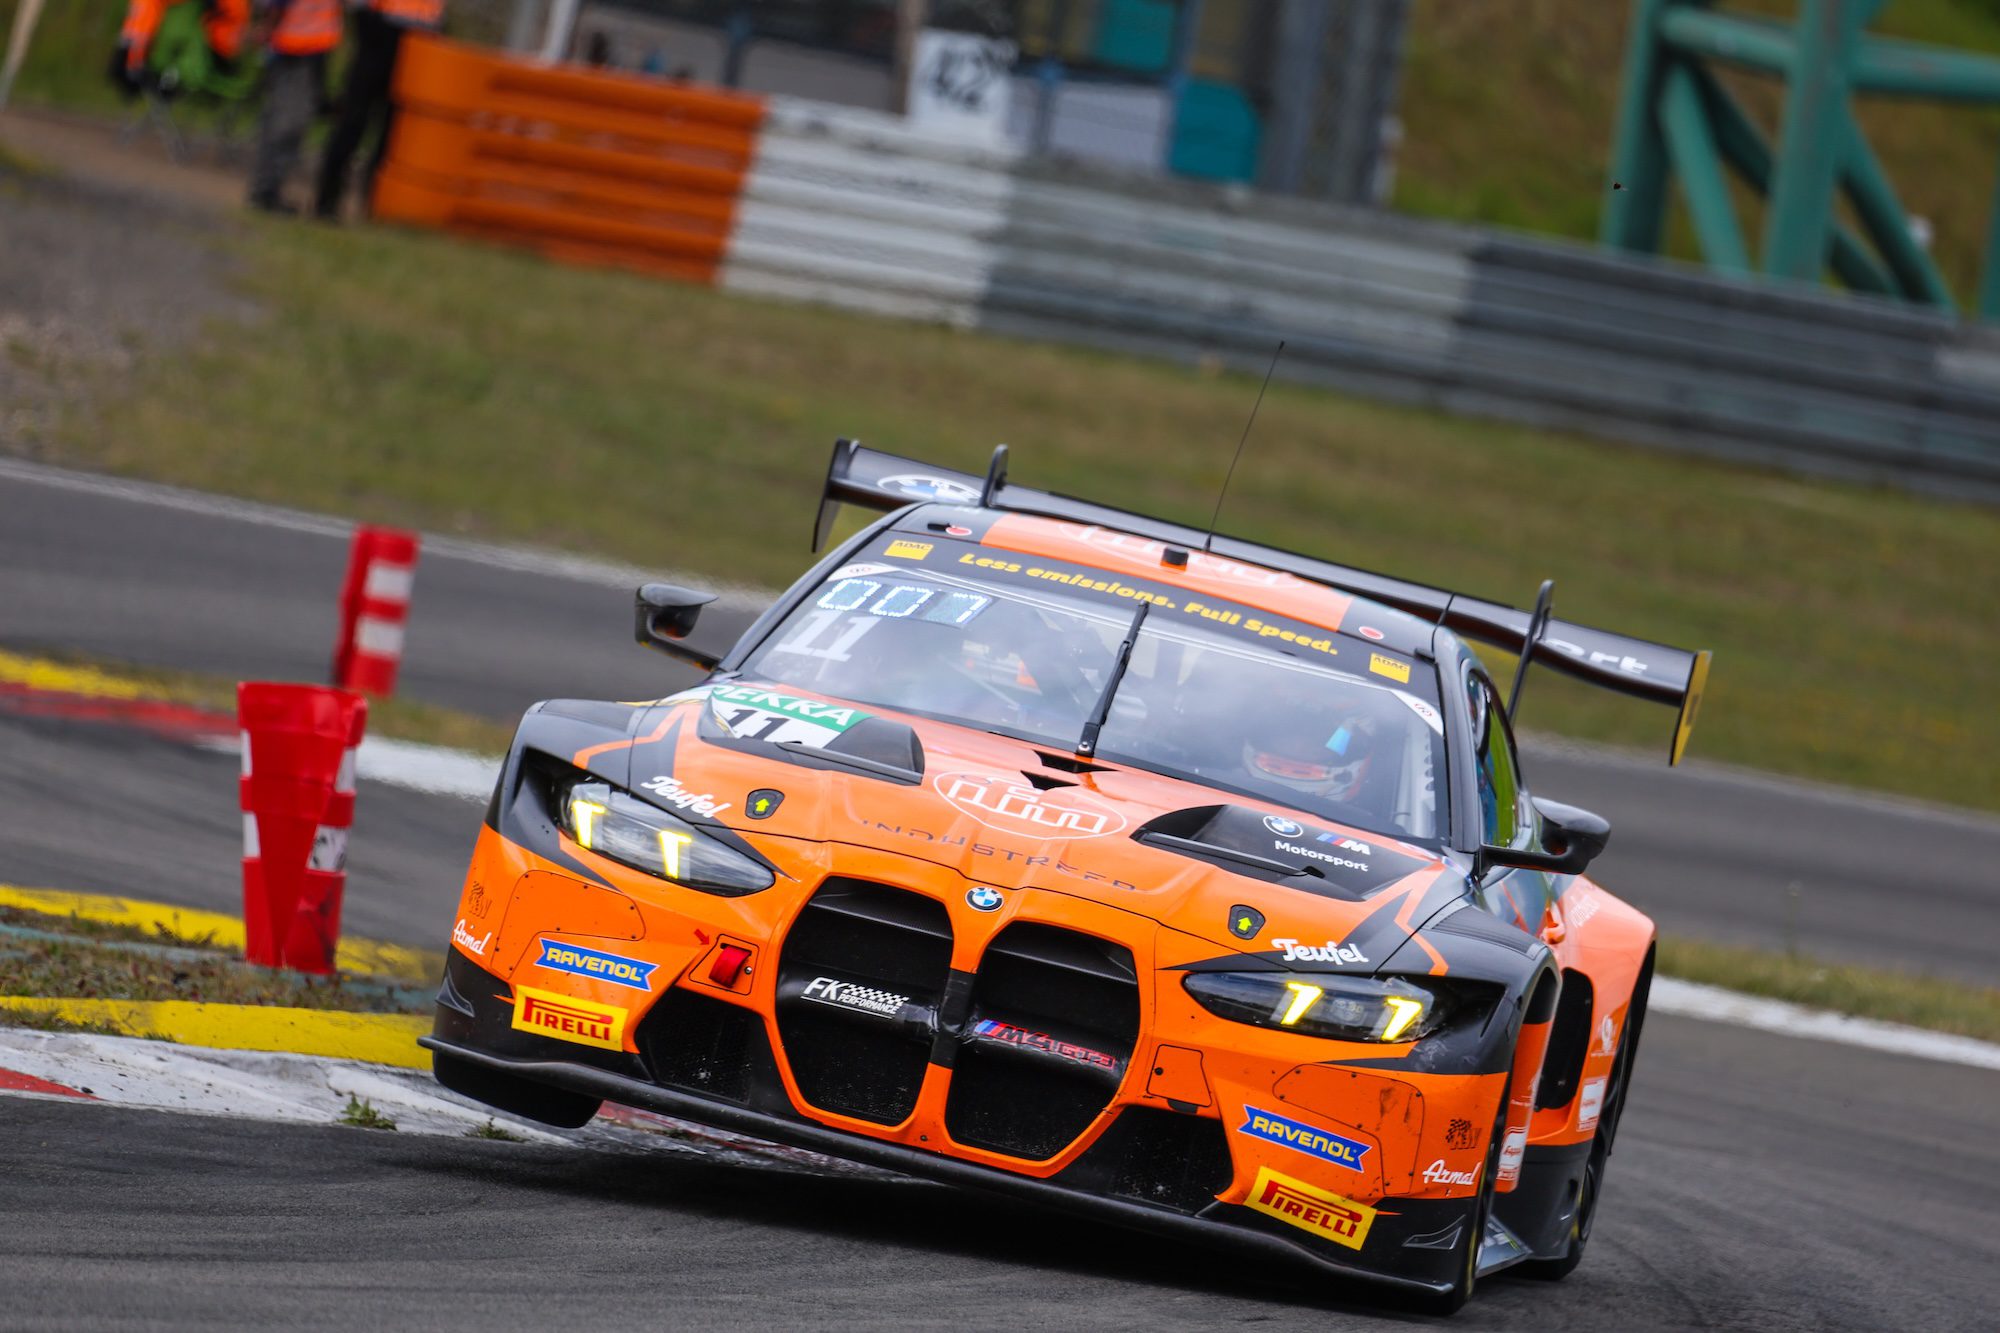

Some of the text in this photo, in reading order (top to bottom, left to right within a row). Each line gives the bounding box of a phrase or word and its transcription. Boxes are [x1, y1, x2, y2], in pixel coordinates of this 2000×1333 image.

[958, 553, 1022, 573] Less
[1025, 566, 1177, 609] emissions.
[1183, 601, 1242, 625] Full
[1242, 618, 1339, 656] Speed.
[773, 610, 883, 662] 11
[640, 775, 733, 819] Teufel
[1274, 840, 1369, 873] Motorsport
[545, 947, 643, 982] RAVENOL
[1270, 937, 1370, 966] Teufel
[803, 976, 850, 1001] FK
[836, 993, 901, 1015] PERFORMANCE
[521, 996, 615, 1041] PIRELLI
[1251, 1115, 1357, 1163] RAVENOL
[1259, 1179, 1364, 1239] PIRELLI
